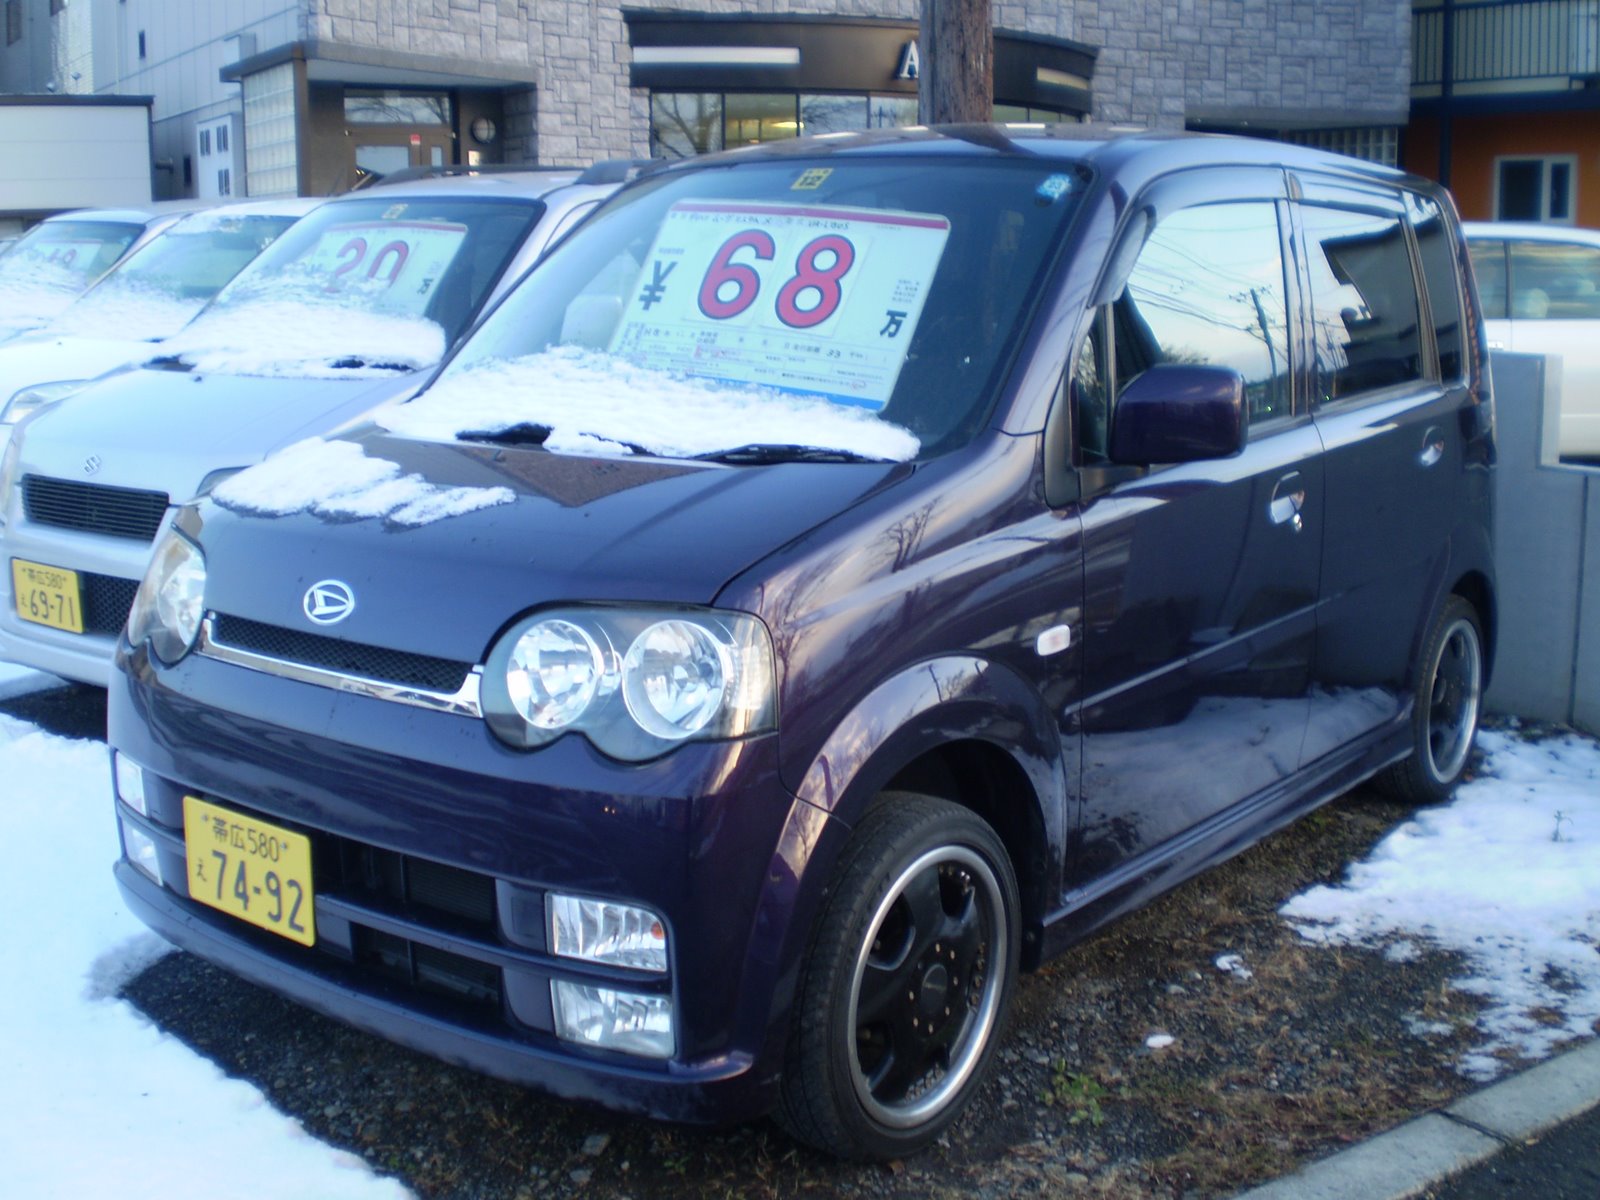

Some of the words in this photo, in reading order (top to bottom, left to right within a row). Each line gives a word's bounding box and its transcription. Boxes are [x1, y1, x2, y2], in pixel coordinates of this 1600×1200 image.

[697, 229, 856, 329] 68
[880, 309, 908, 338] 万
[30, 588, 75, 627] 69-71
[212, 816, 280, 863] 帯広580
[211, 849, 305, 934] 74-92
